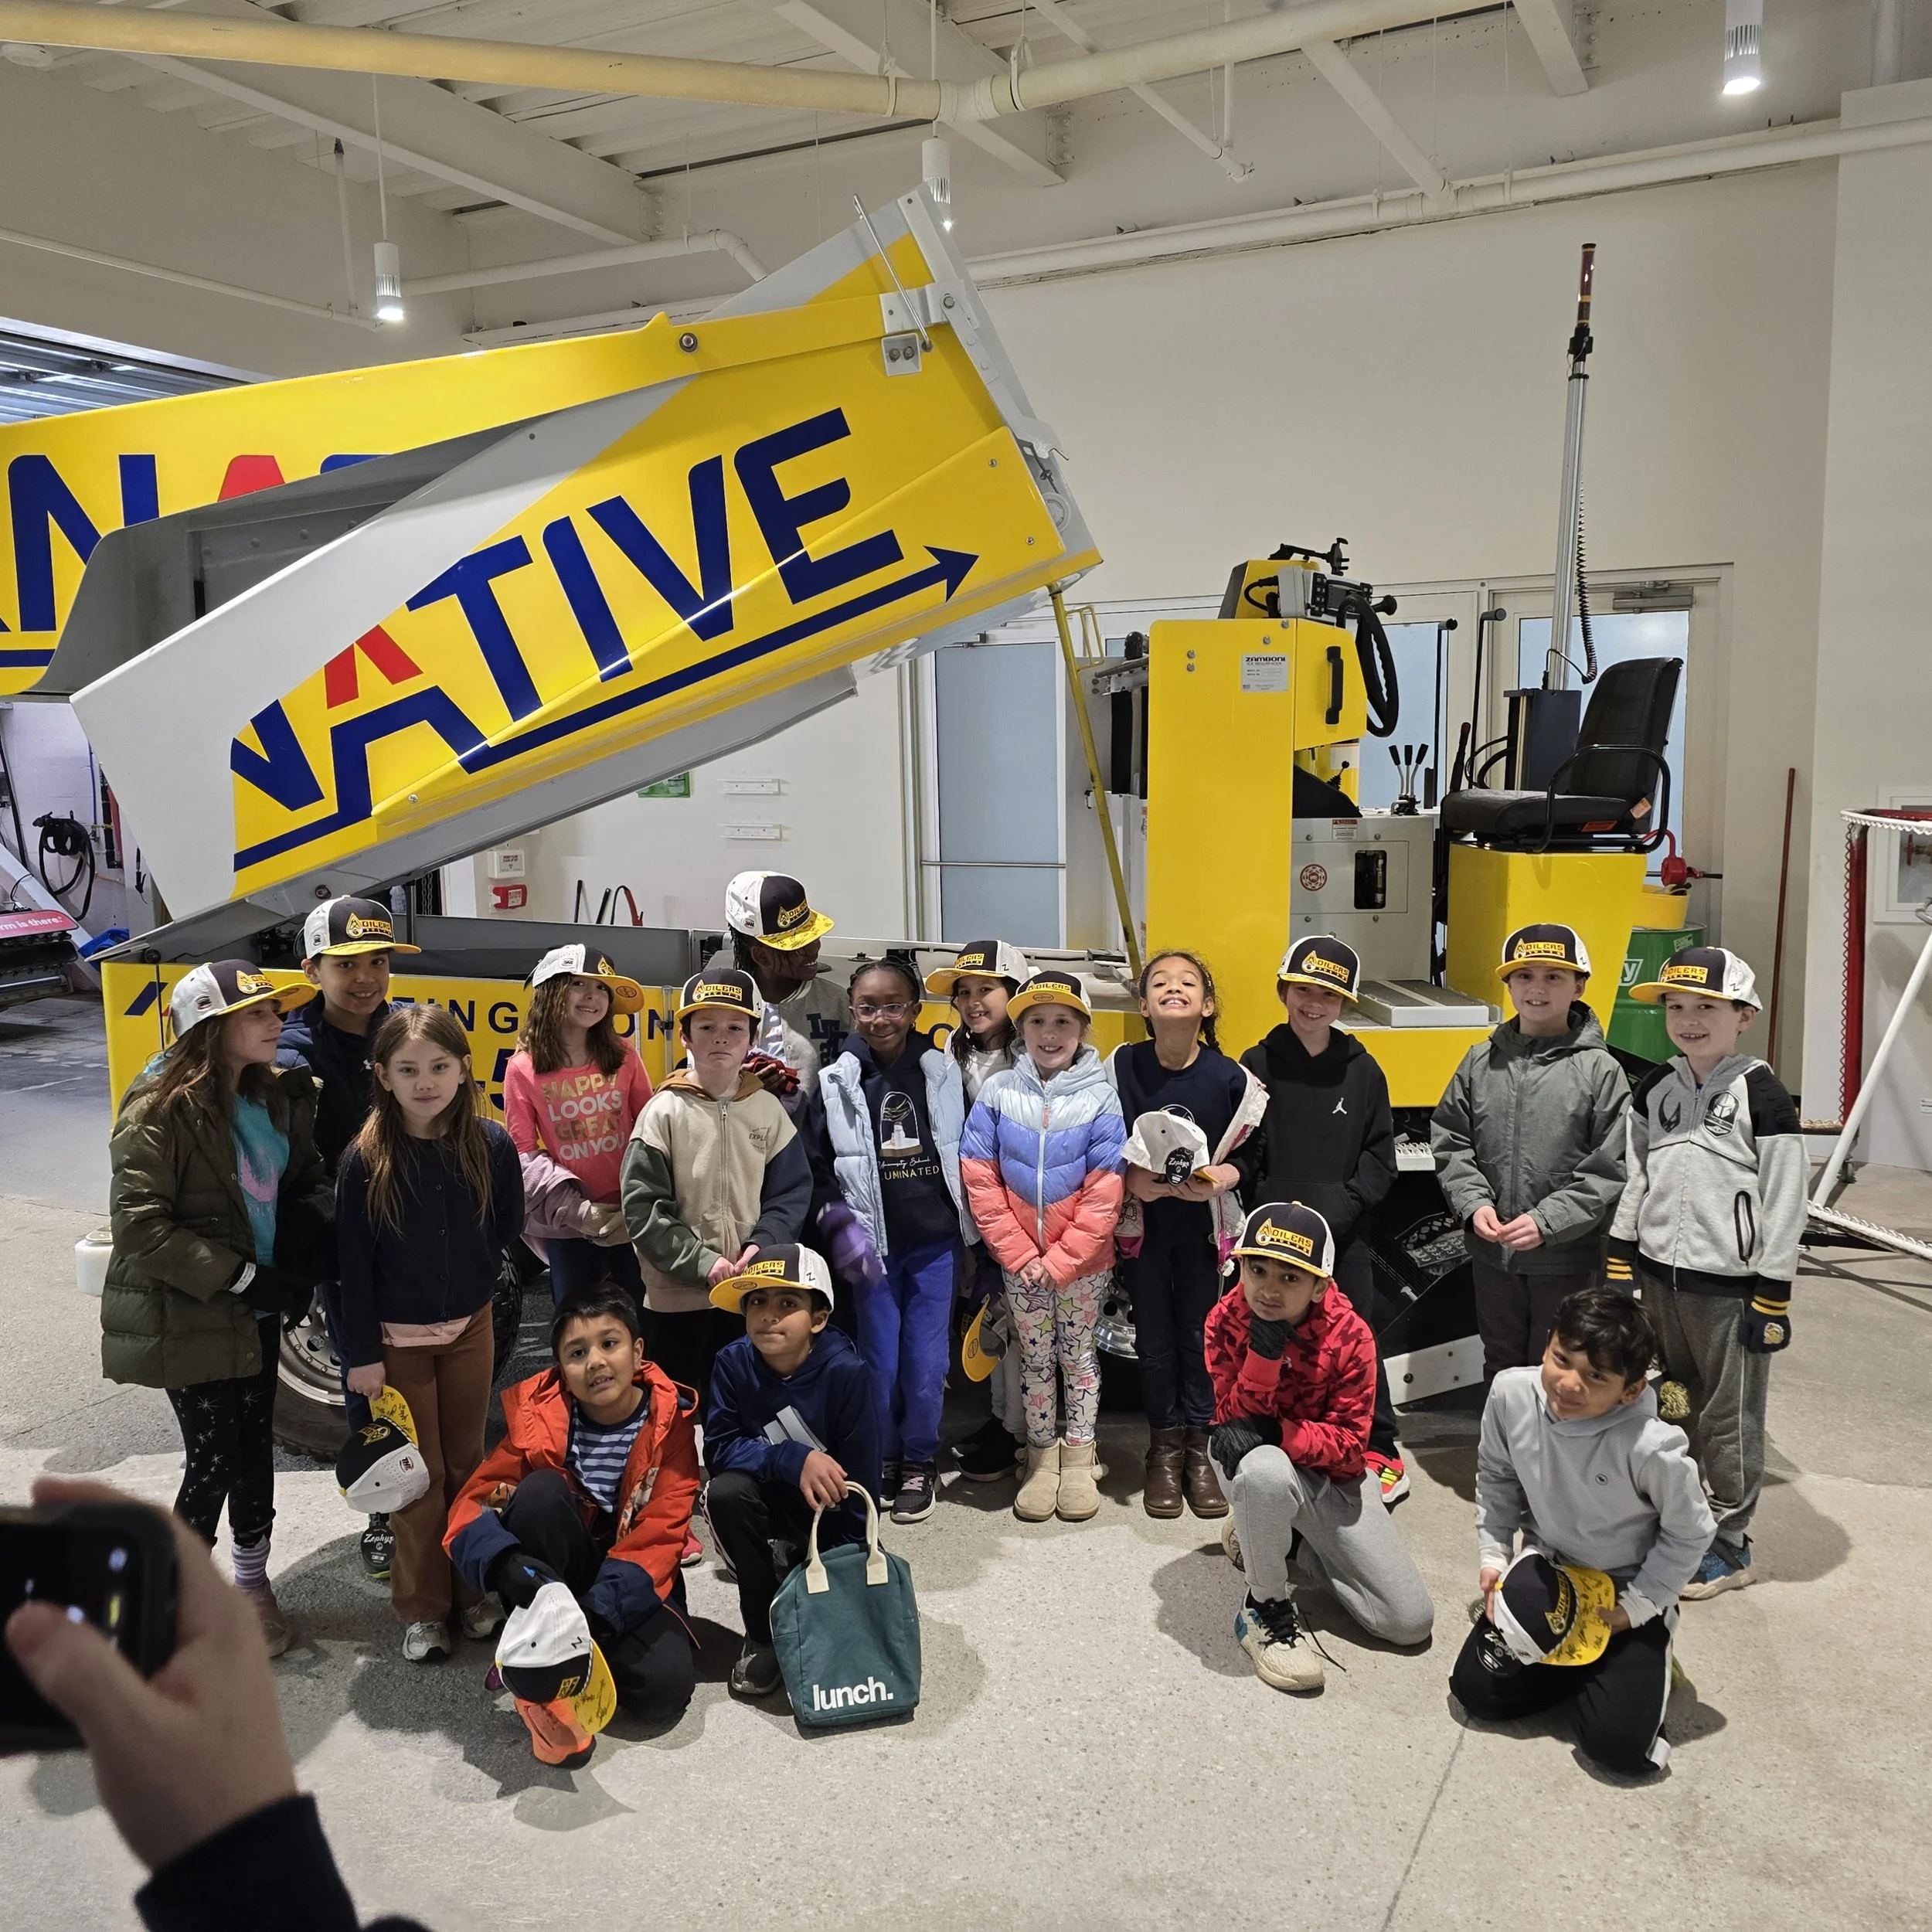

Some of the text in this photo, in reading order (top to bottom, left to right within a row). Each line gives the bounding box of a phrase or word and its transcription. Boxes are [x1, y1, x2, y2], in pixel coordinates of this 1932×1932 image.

[1317, 960, 1349, 976] OILERS
[706, 985, 742, 995] OILERS
[548, 1090, 622, 1122] LOOKS
[559, 1131, 626, 1161] ON YOU
[1272, 1229, 1312, 1247] OILERS
[363, 1533, 395, 1544] Zephyr
[812, 1676, 894, 1711] lunch.
